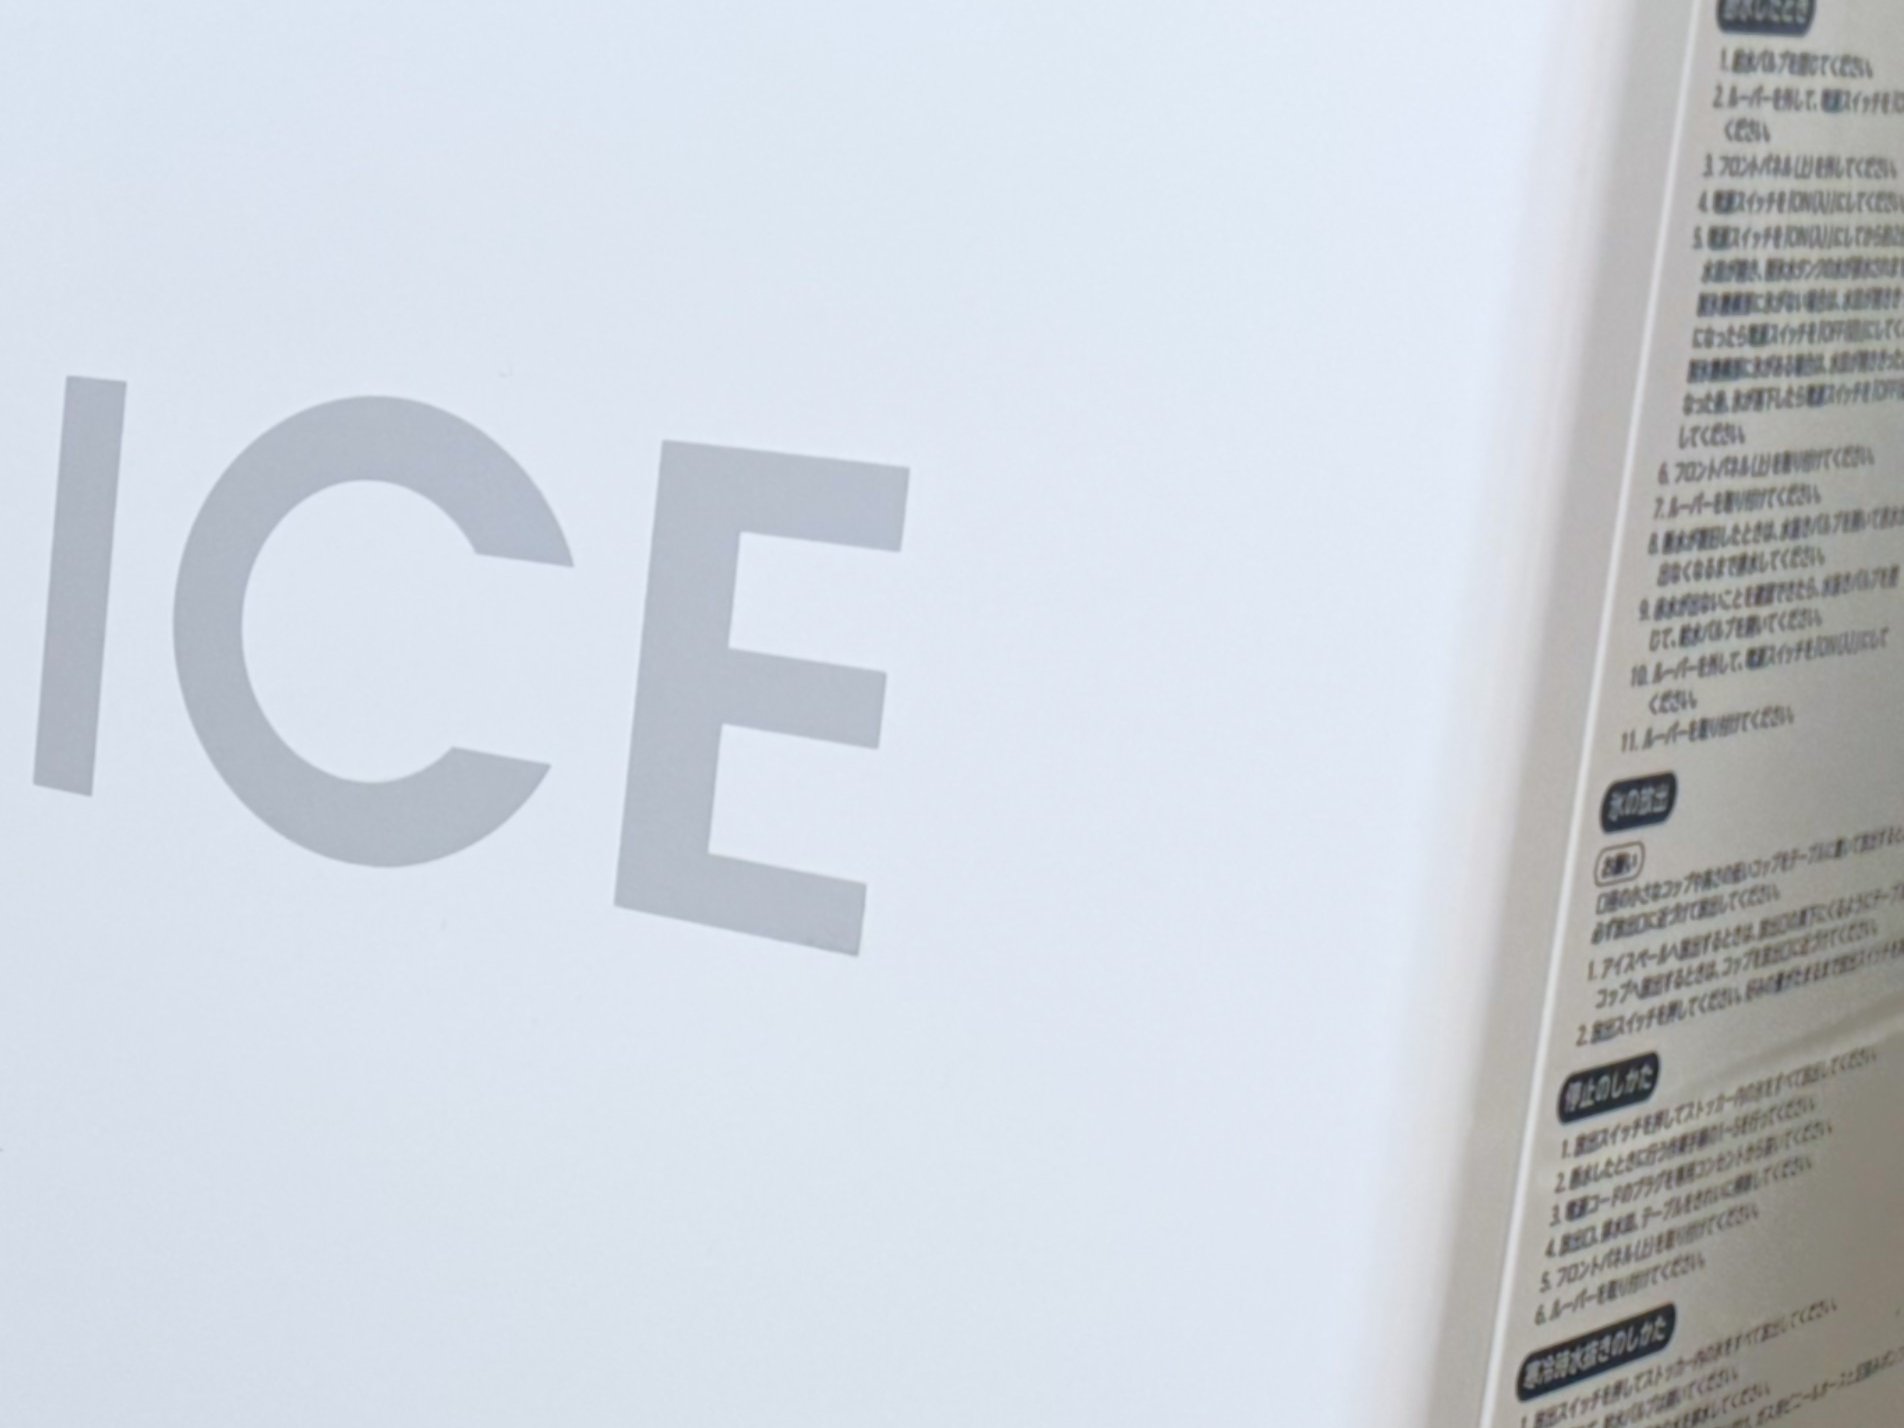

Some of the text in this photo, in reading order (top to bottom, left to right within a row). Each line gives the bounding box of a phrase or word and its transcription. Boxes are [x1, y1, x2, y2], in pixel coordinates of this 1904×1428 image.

[33, 375, 910, 956] ICE
[1606, 781, 1672, 824] 氷の放出
[1562, 1059, 1655, 1115] 停止のしかた
[1521, 1311, 1670, 1394] 寒冷時水抜きのしかた
